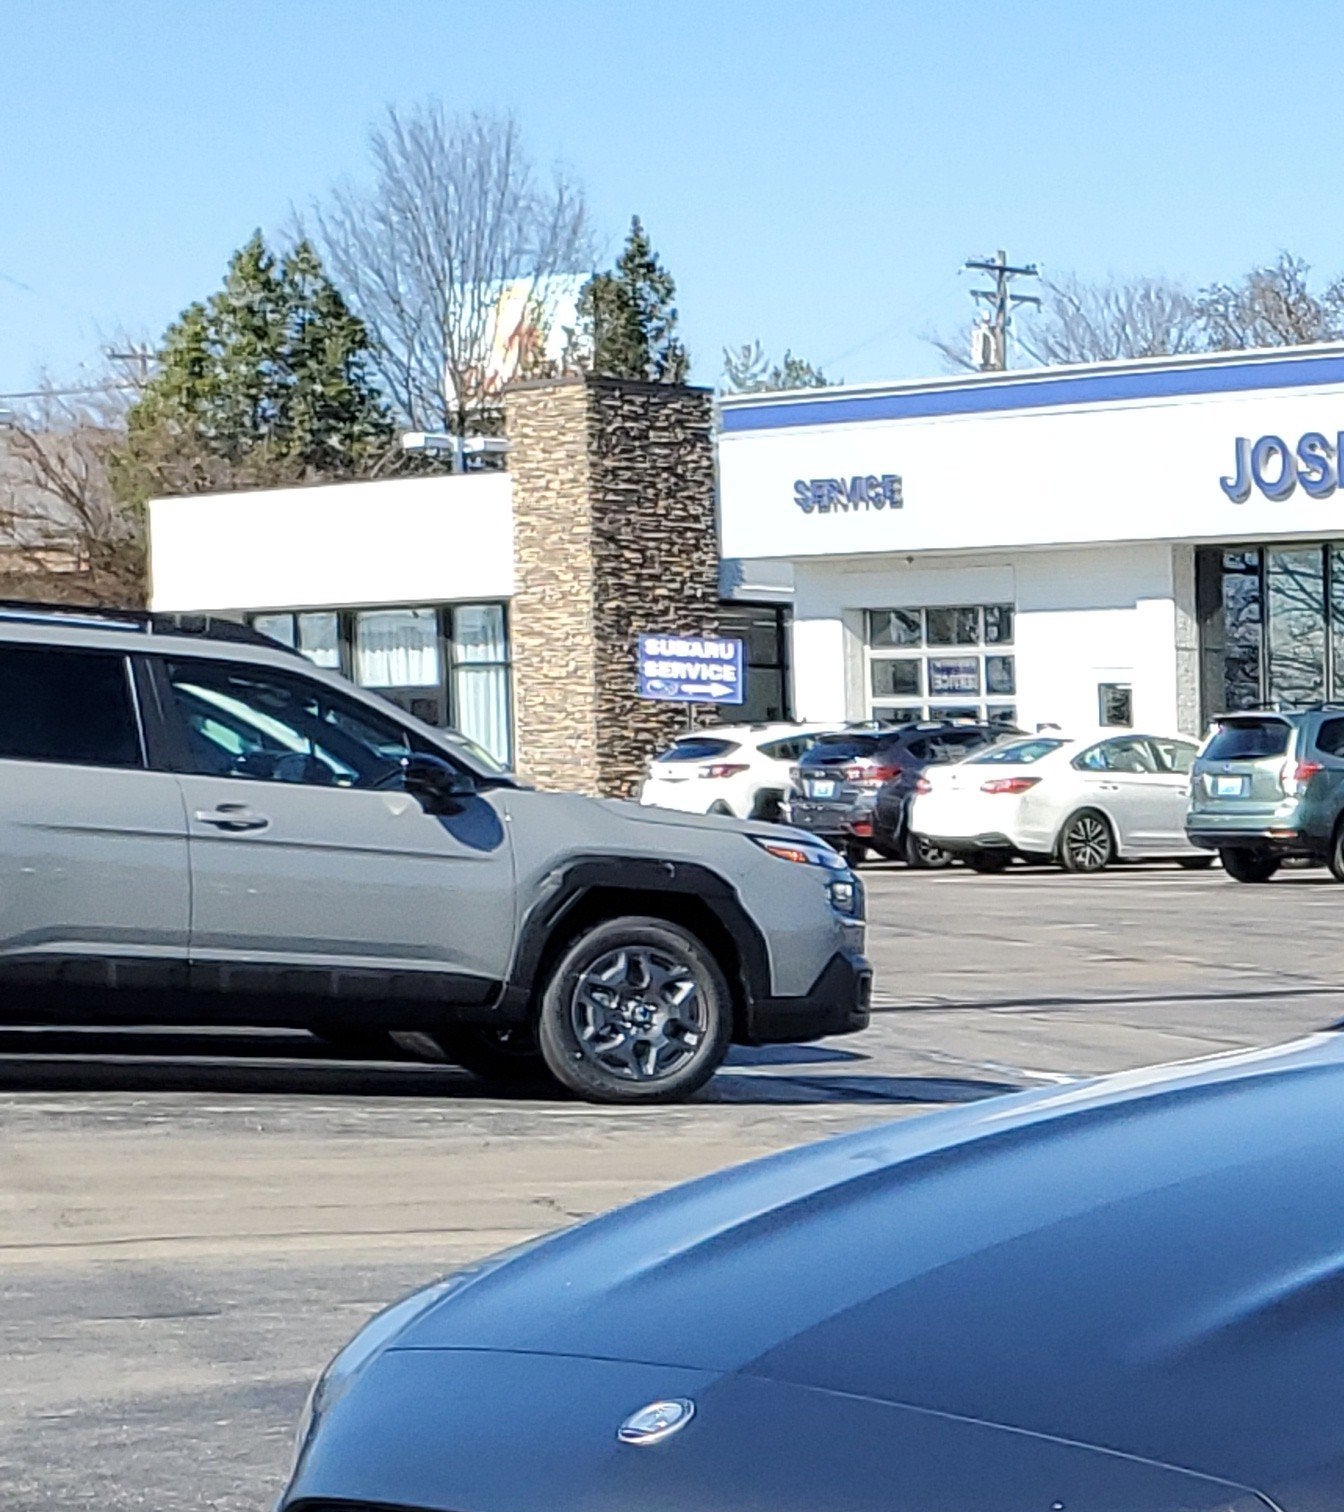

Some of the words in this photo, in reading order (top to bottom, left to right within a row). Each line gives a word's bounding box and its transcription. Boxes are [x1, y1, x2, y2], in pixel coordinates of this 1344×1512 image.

[793, 474, 903, 514] SERVICE
[644, 638, 735, 660] SUBARU
[643, 660, 737, 682] SERVICE
